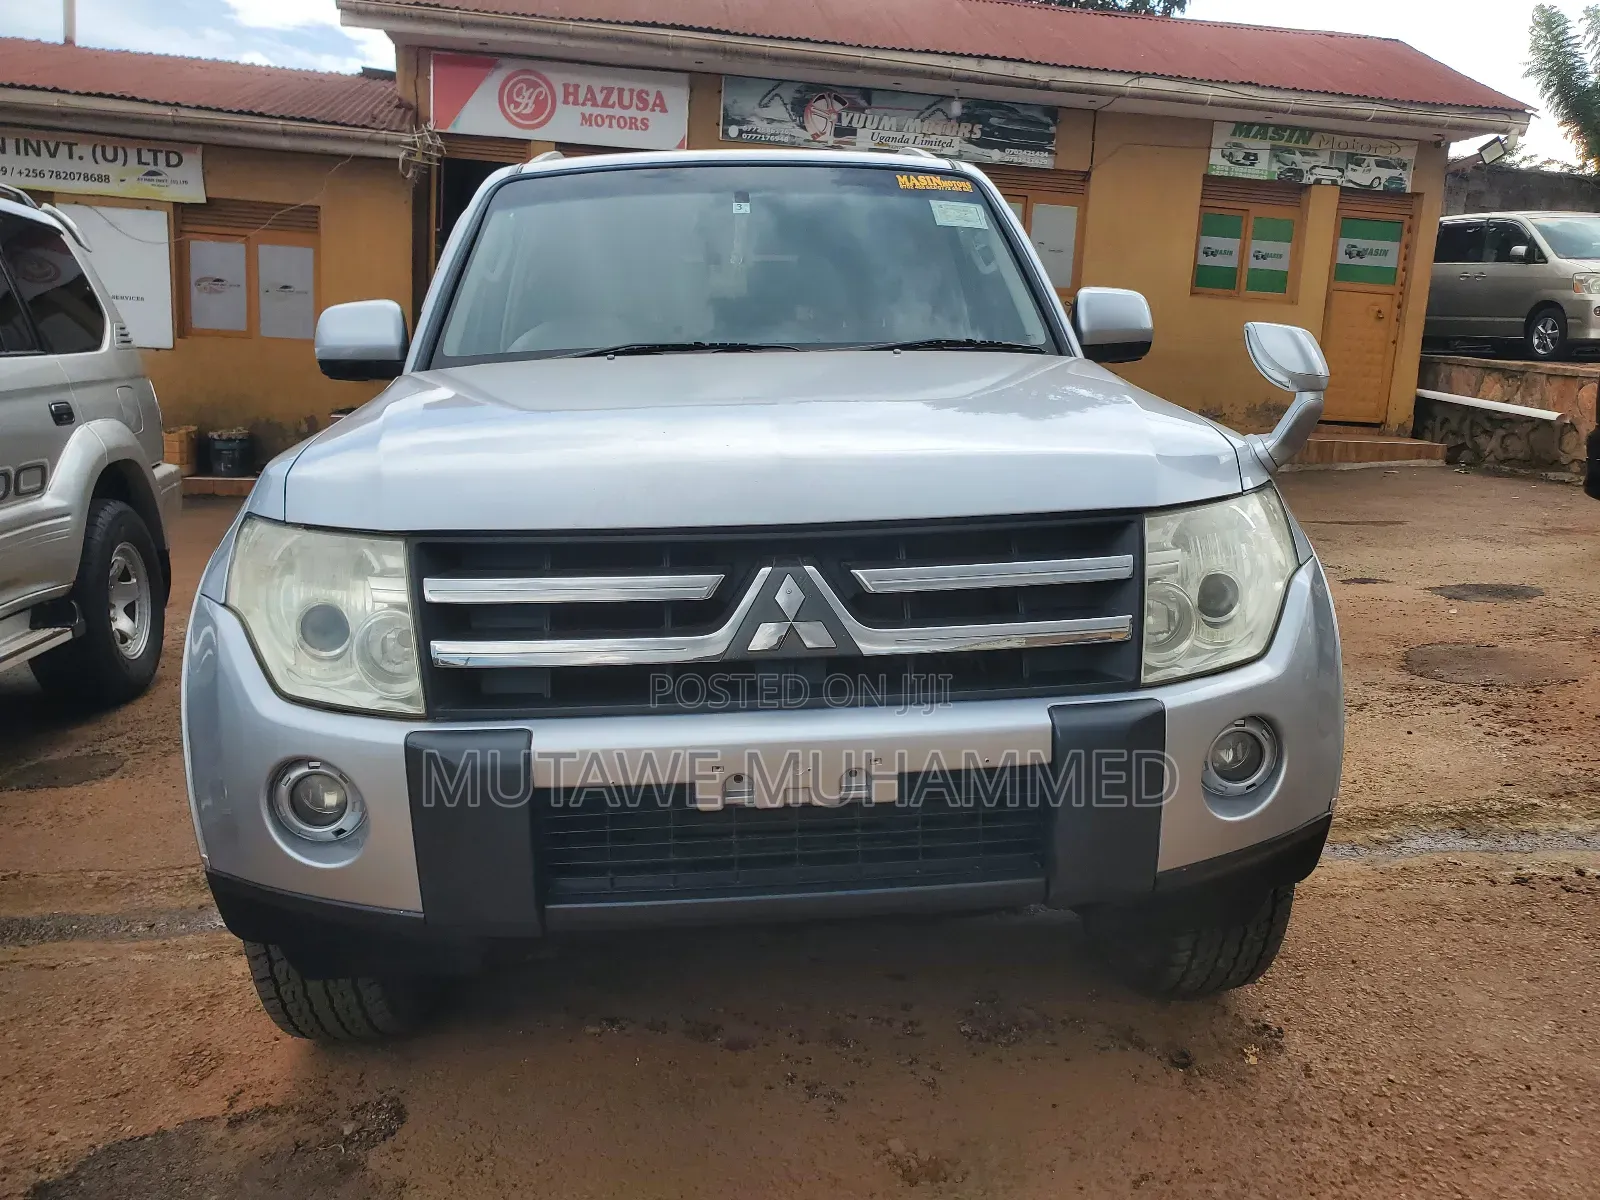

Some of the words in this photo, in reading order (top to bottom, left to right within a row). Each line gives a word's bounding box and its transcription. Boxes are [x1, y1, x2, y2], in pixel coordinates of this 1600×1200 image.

[562, 83, 668, 113] HAZUSA
[580, 112, 650, 131] MOTORS
[841, 111, 897, 131] VUUM
[903, 118, 982, 139] MOTORS
[870, 132, 909, 145] Uganda
[912, 134, 955, 148] Limited.
[1230, 121, 1315, 145] MASIN
[1318, 135, 1400, 155] Motors
[15, 138, 84, 160] INVT.
[92, 143, 128, 167] (U)
[137, 148, 183, 168] LTD
[17, 168, 45, 178] +256
[48, 170, 110, 183] 782078688
[896, 175, 942, 187] MASIN
[941, 180, 971, 189] MOTORS
[1214, 248, 1233, 256] MASIN
[1361, 248, 1389, 257] MASIN
